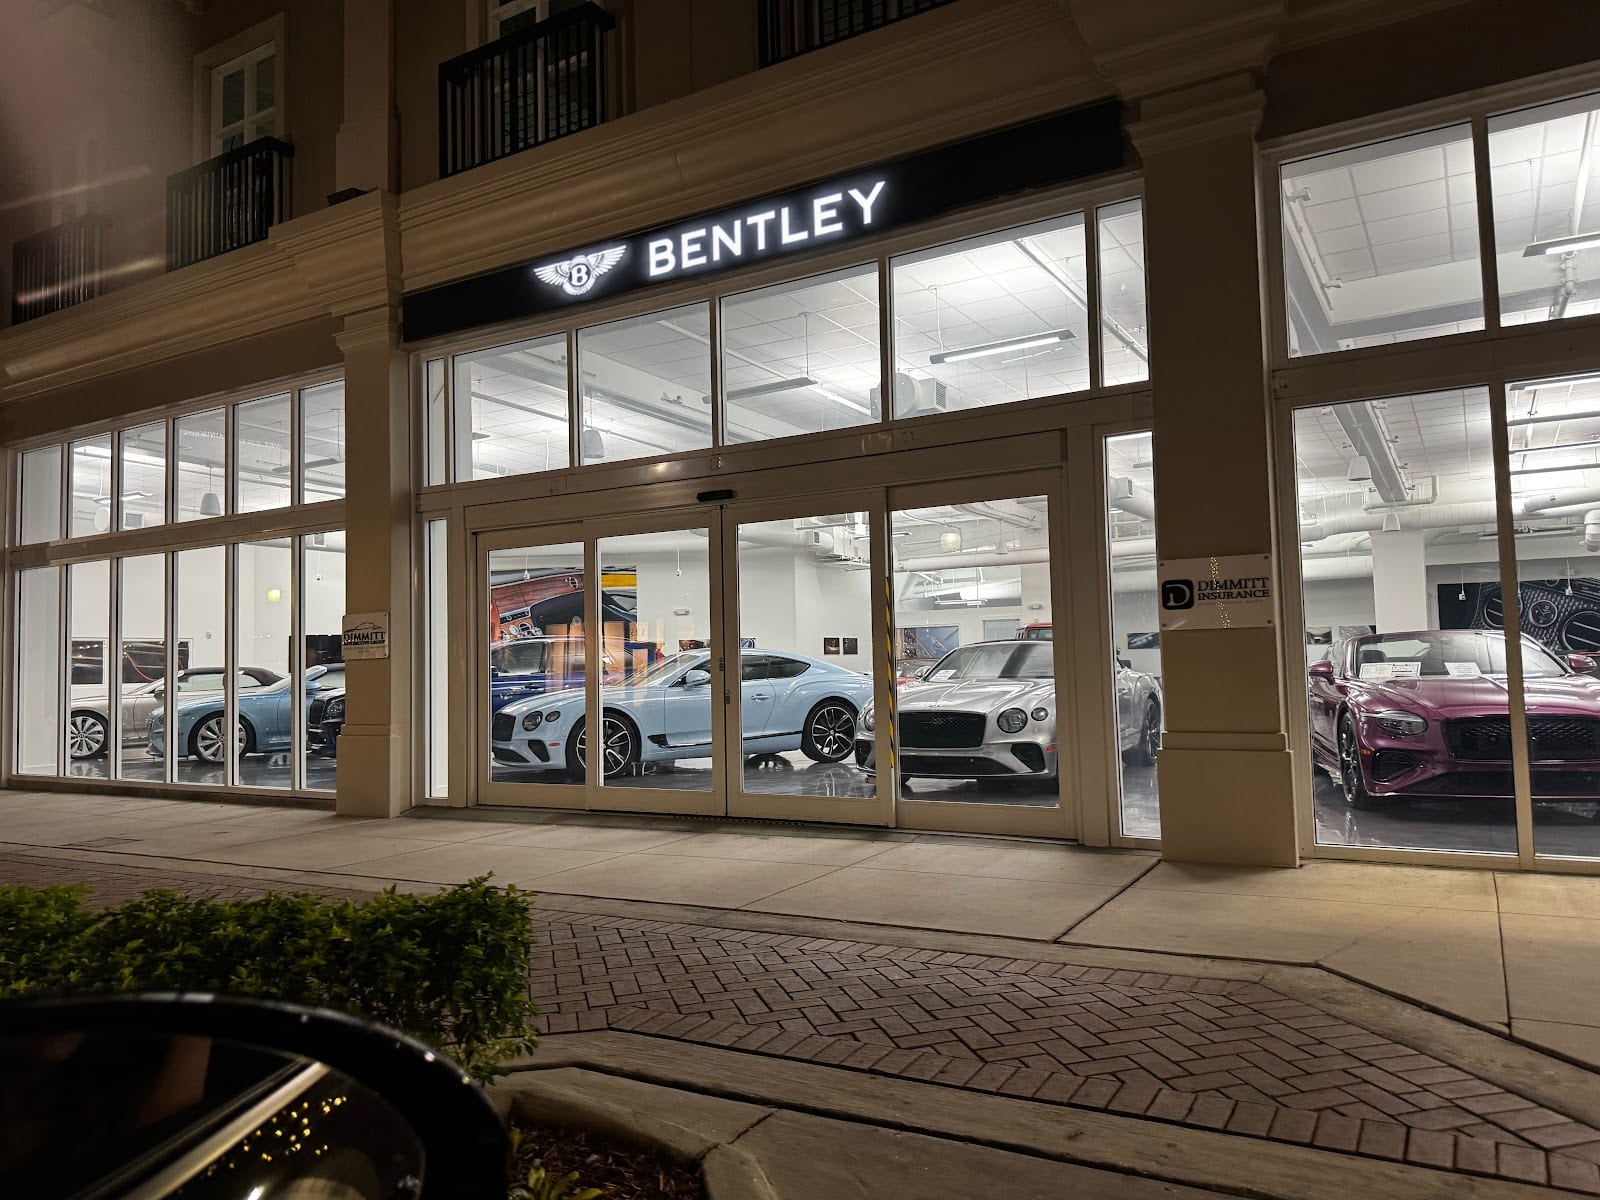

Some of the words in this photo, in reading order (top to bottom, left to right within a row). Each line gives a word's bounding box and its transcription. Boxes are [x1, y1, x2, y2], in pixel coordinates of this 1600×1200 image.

[648, 181, 886, 276] BENTLEY
[571, 265, 588, 286] B
[1198, 577, 1269, 591] DIMMITT
[1198, 590, 1270, 601] INSURANCE
[343, 631, 386, 641] DIMMITT
